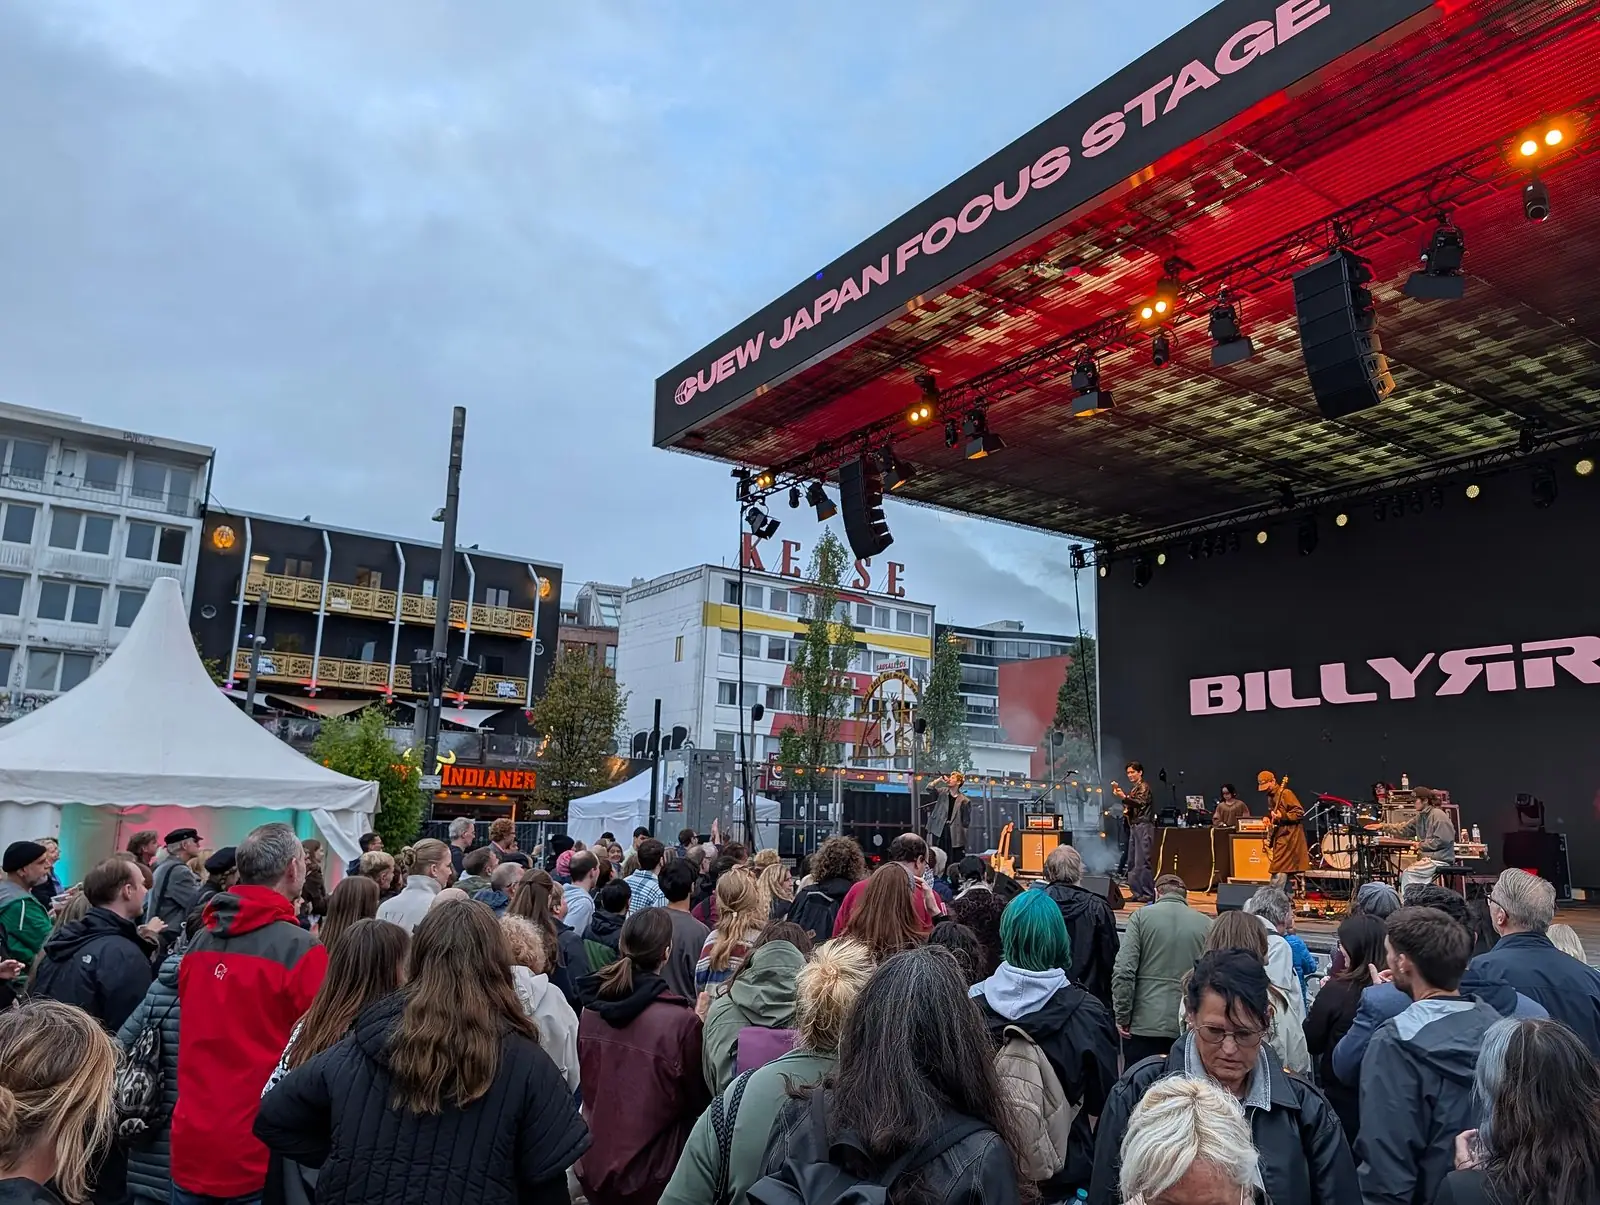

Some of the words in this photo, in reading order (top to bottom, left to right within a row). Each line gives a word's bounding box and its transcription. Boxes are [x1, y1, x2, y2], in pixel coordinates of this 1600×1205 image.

[769, 253, 890, 350] JAPAN
[896, 146, 1071, 275] FOCUS
[1081, 0, 1330, 158] STAGE
[742, 532, 905, 597] KESE
[442, 764, 537, 790] INDIANER
